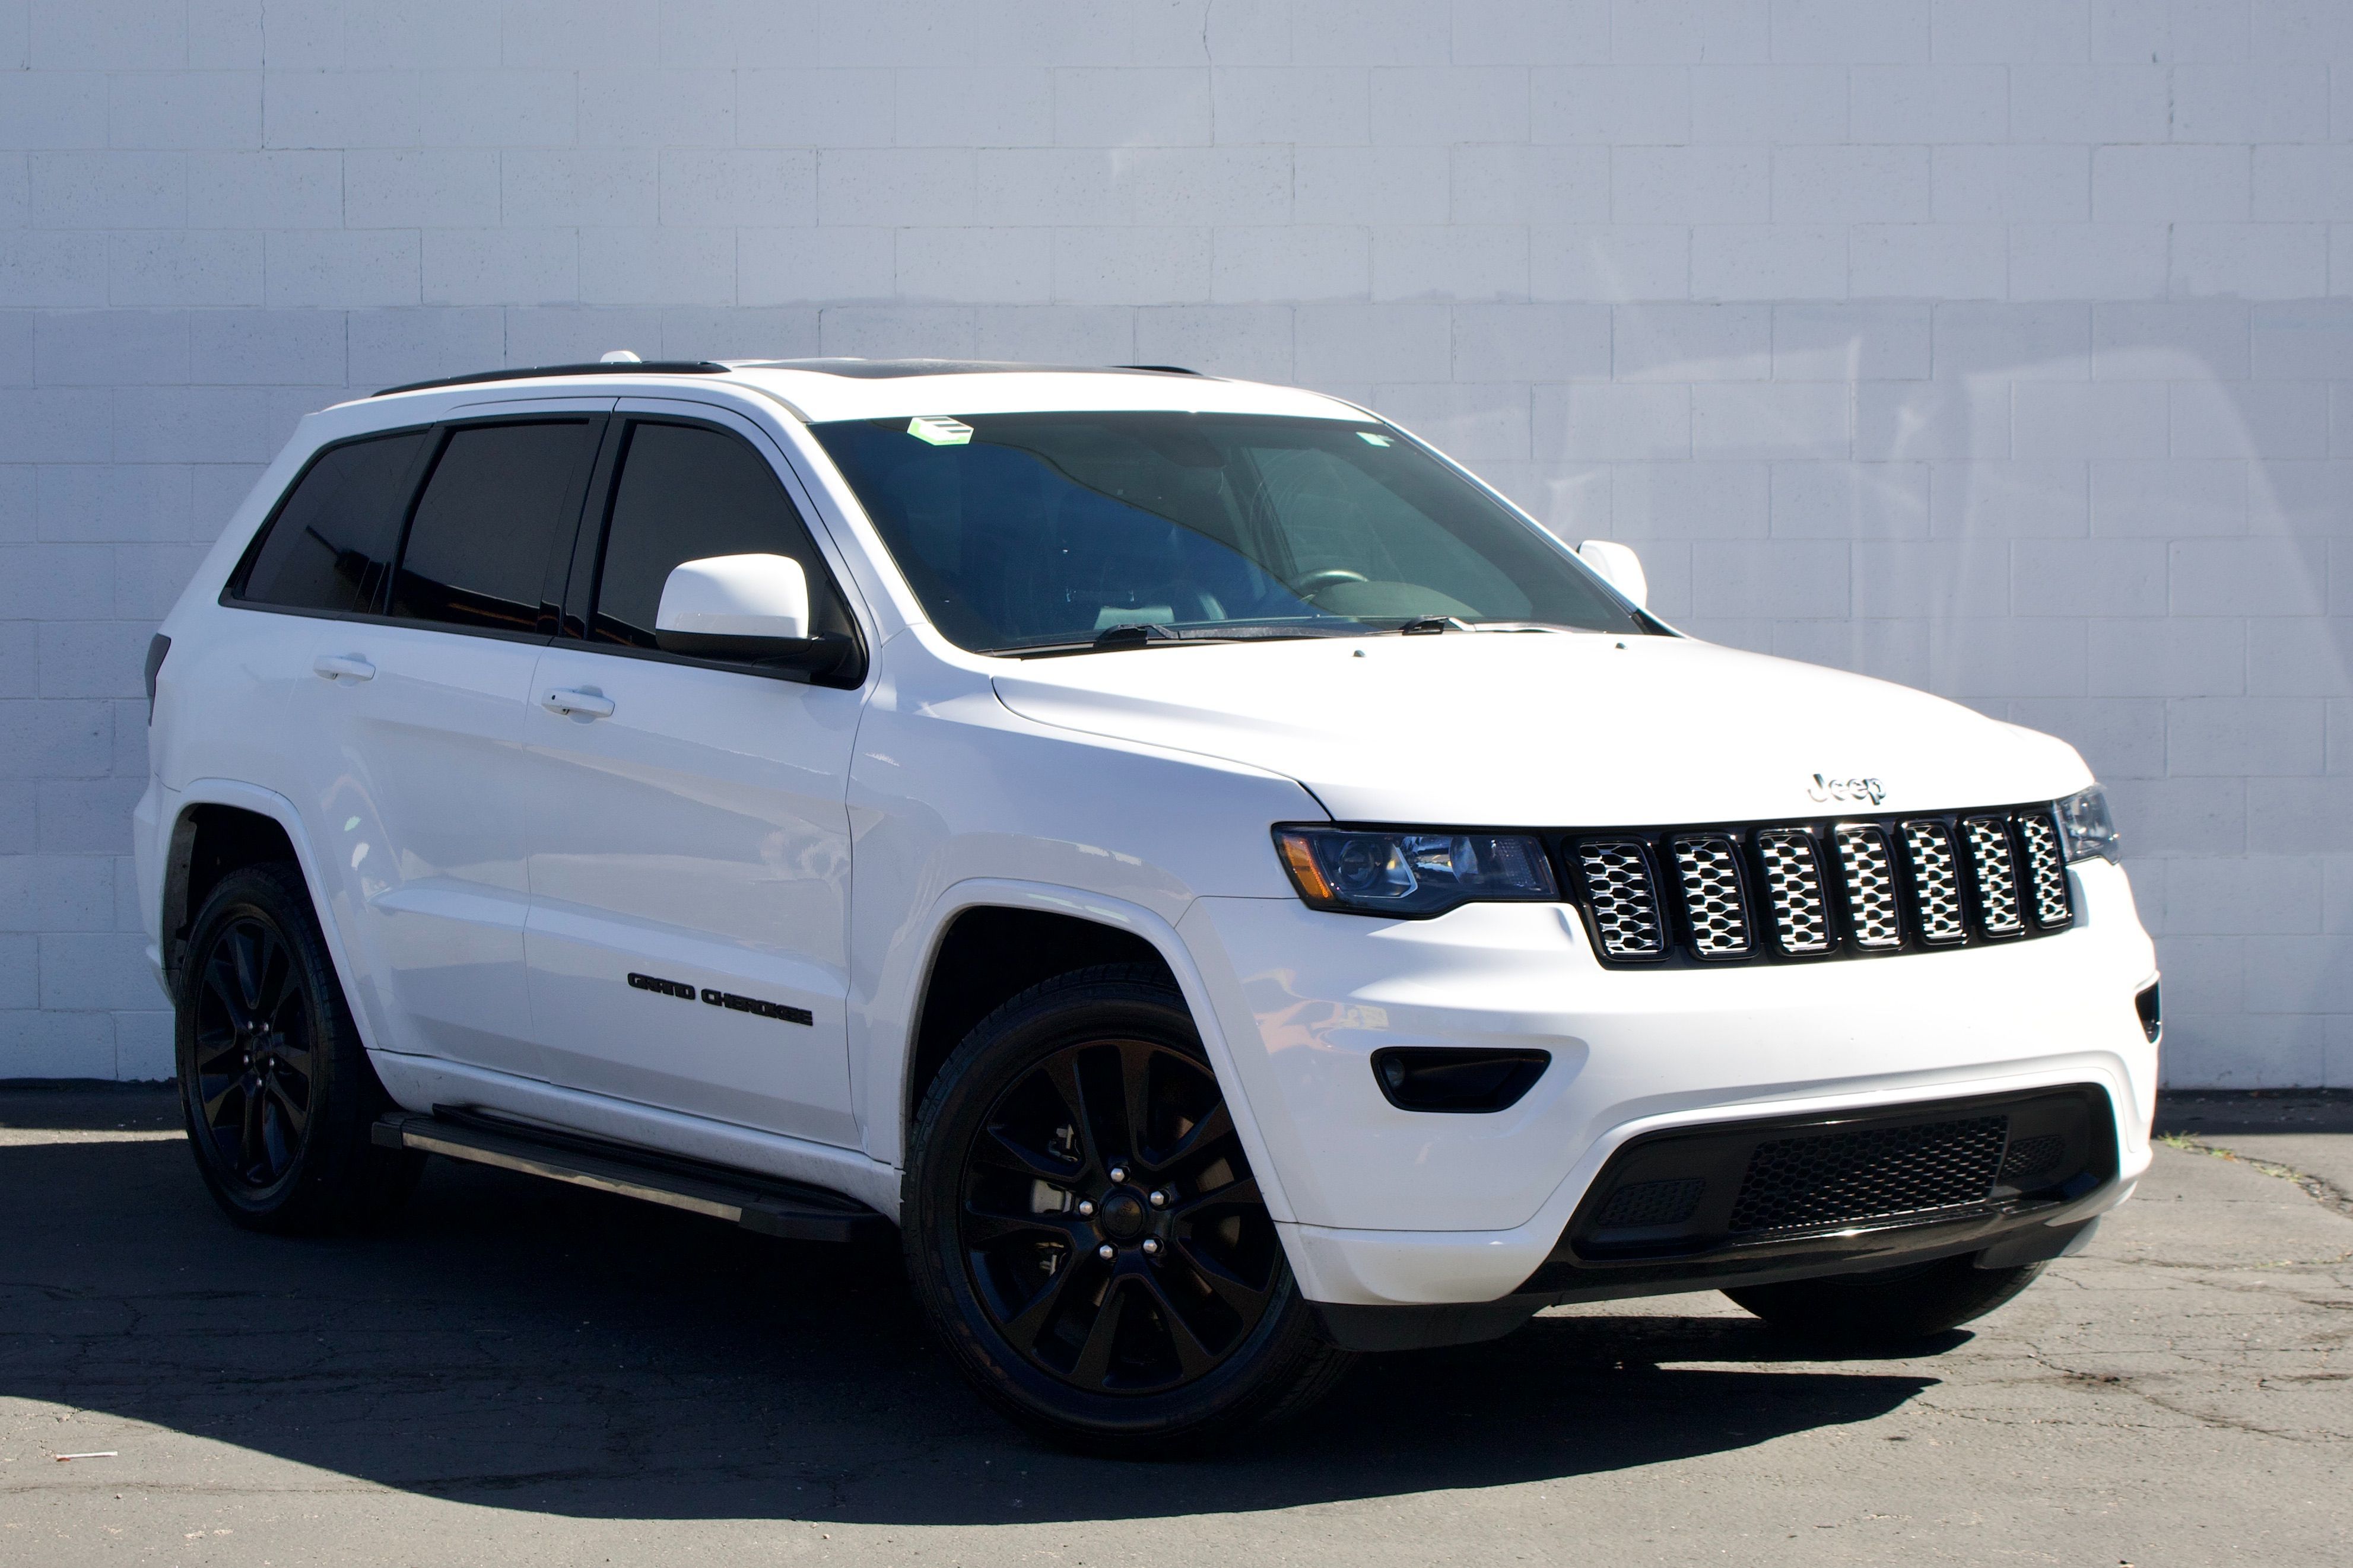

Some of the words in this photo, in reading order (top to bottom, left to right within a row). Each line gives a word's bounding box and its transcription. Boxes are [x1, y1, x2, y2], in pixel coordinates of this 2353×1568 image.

[1807, 773, 1887, 806] Jeep
[627, 972, 696, 1000] GRAND
[701, 988, 814, 1026] CHEROKEE
